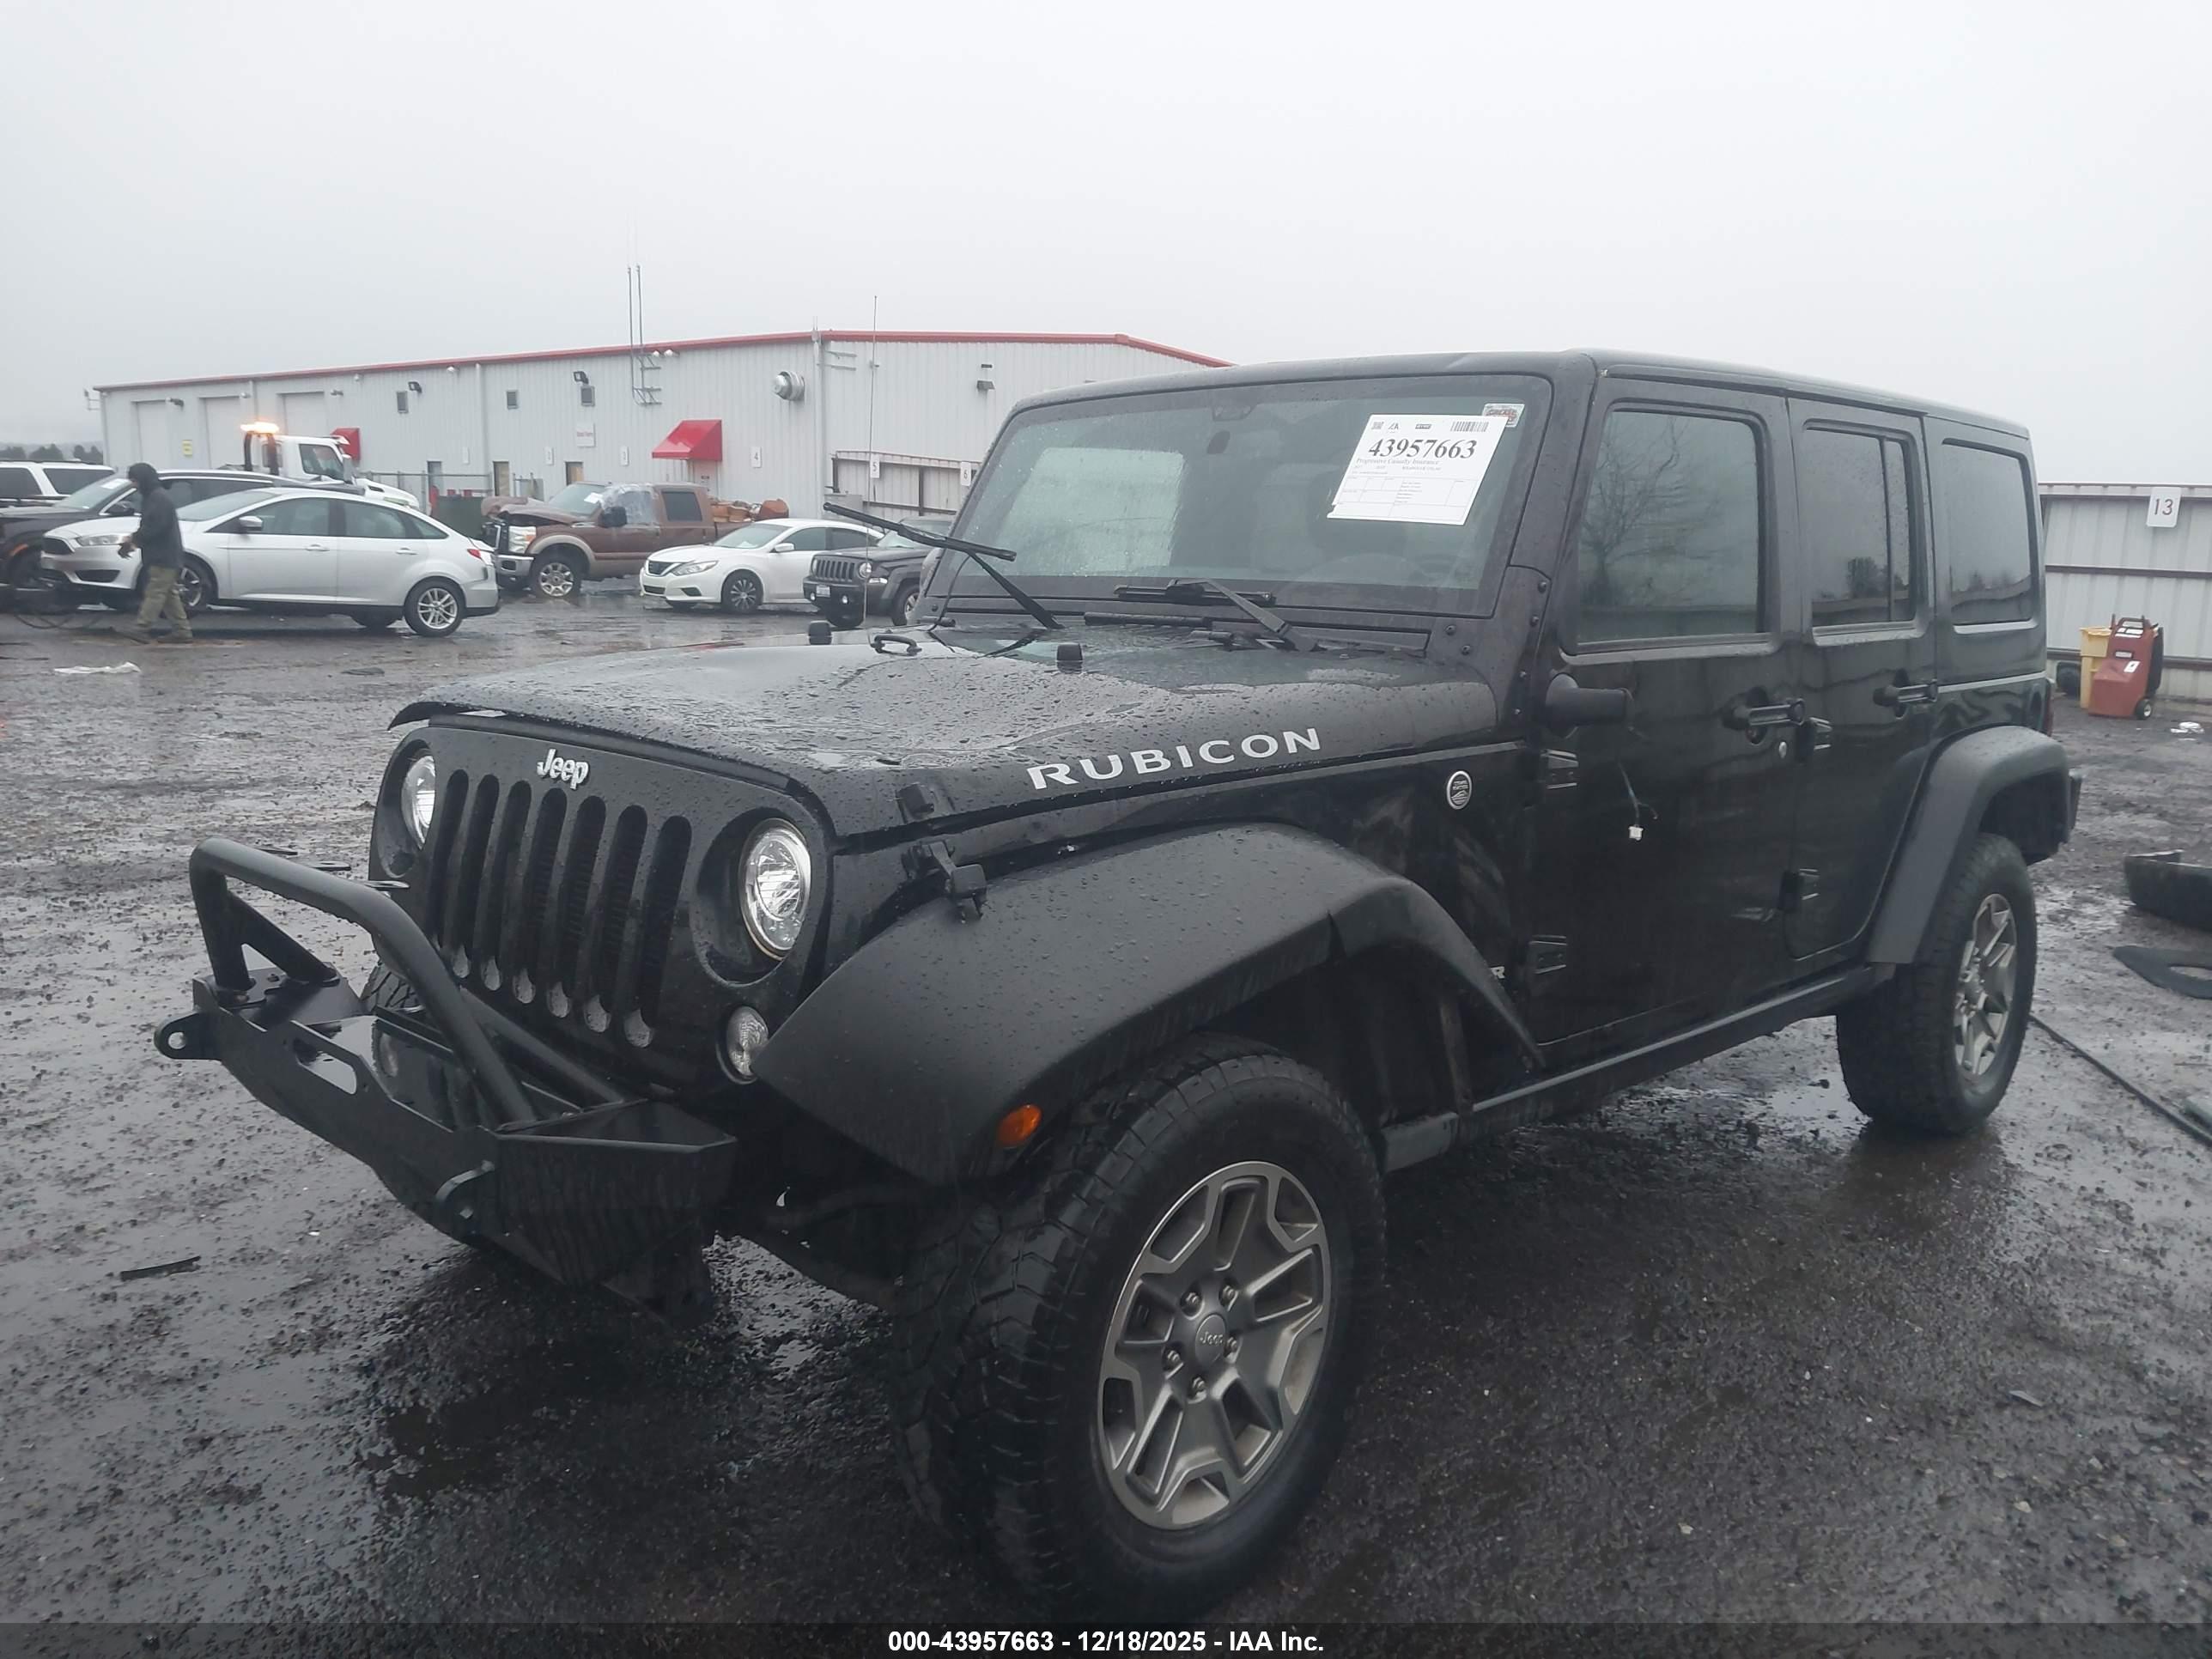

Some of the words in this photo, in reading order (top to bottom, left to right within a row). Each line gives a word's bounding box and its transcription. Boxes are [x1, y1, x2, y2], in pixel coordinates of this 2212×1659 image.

[1368, 437, 1478, 459] 43957663
[2154, 498, 2174, 516] 13
[536, 748, 589, 790] Jeep
[1025, 726, 1322, 790] RUBICON
